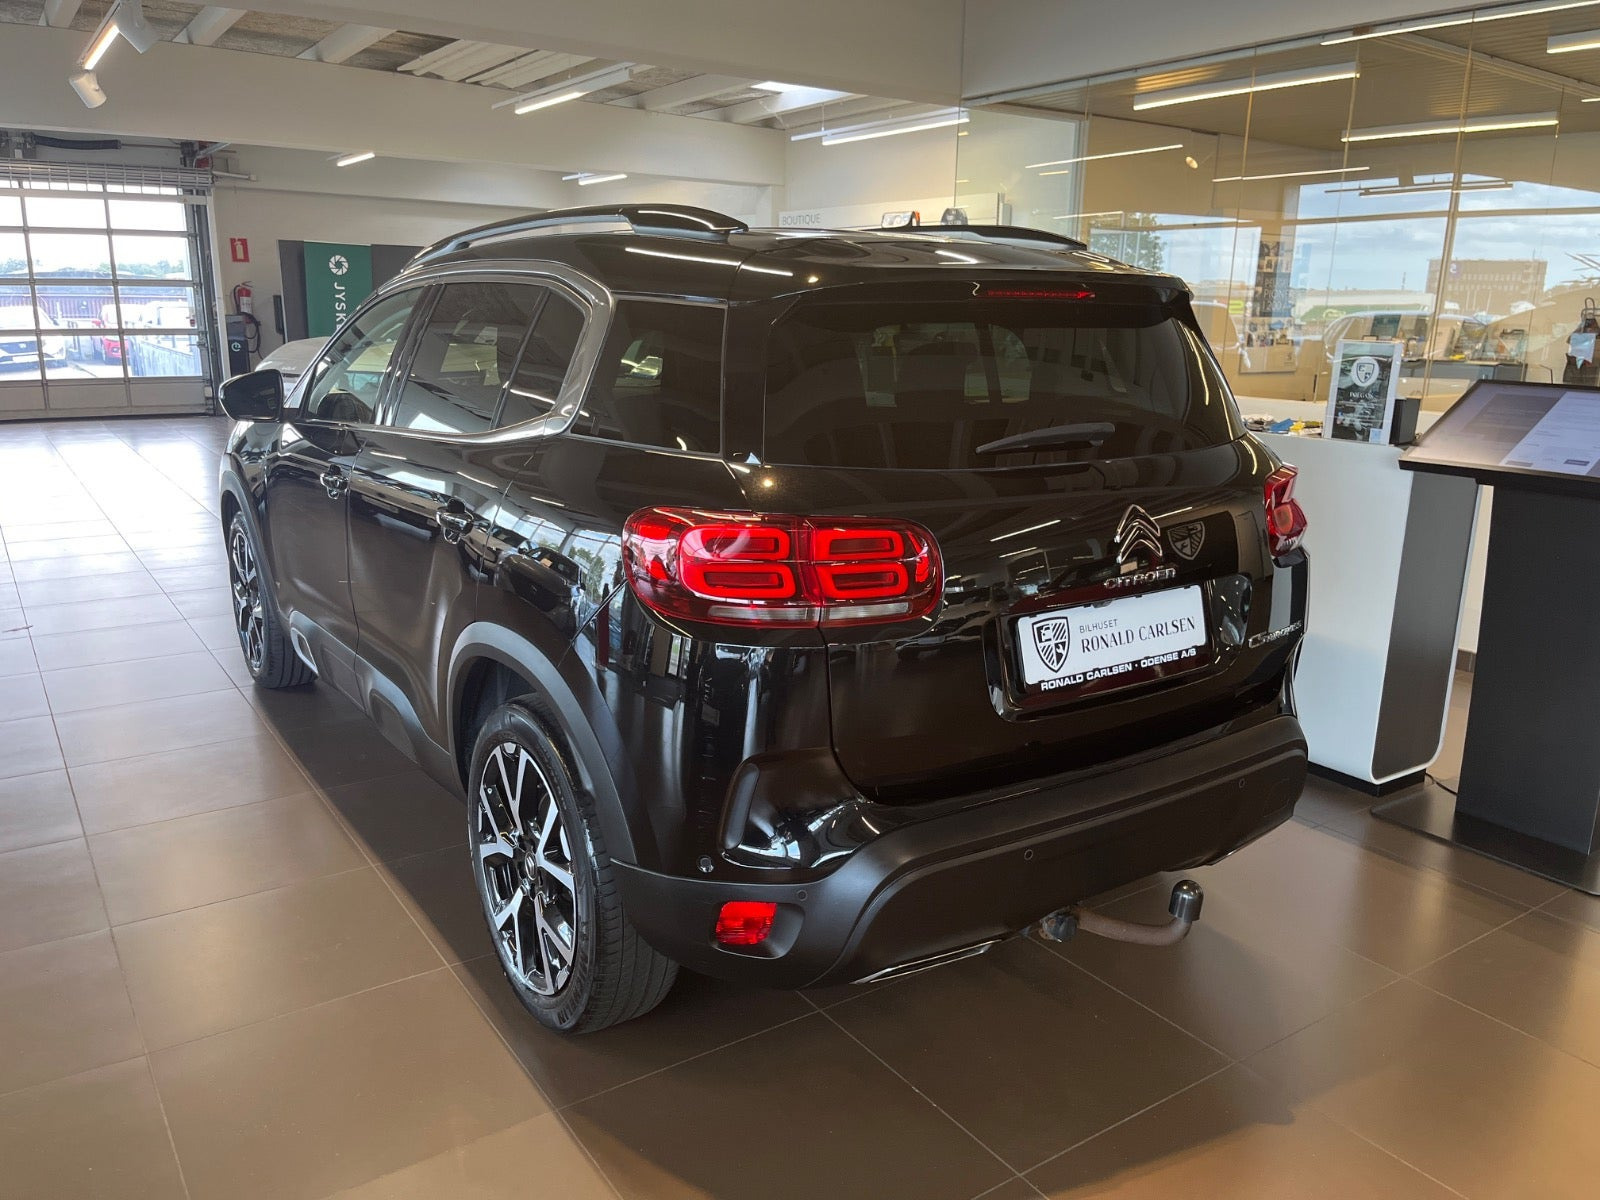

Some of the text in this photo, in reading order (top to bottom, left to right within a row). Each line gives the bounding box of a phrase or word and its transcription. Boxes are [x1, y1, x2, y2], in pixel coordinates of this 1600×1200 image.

[782, 213, 821, 226] BOUTIQUE
[1079, 619, 1118, 634] BILHUSET
[1081, 616, 1196, 654] RONALD CARLSEN
[1040, 648, 1197, 691] RONALD CARLSEN ODENSE A/S
